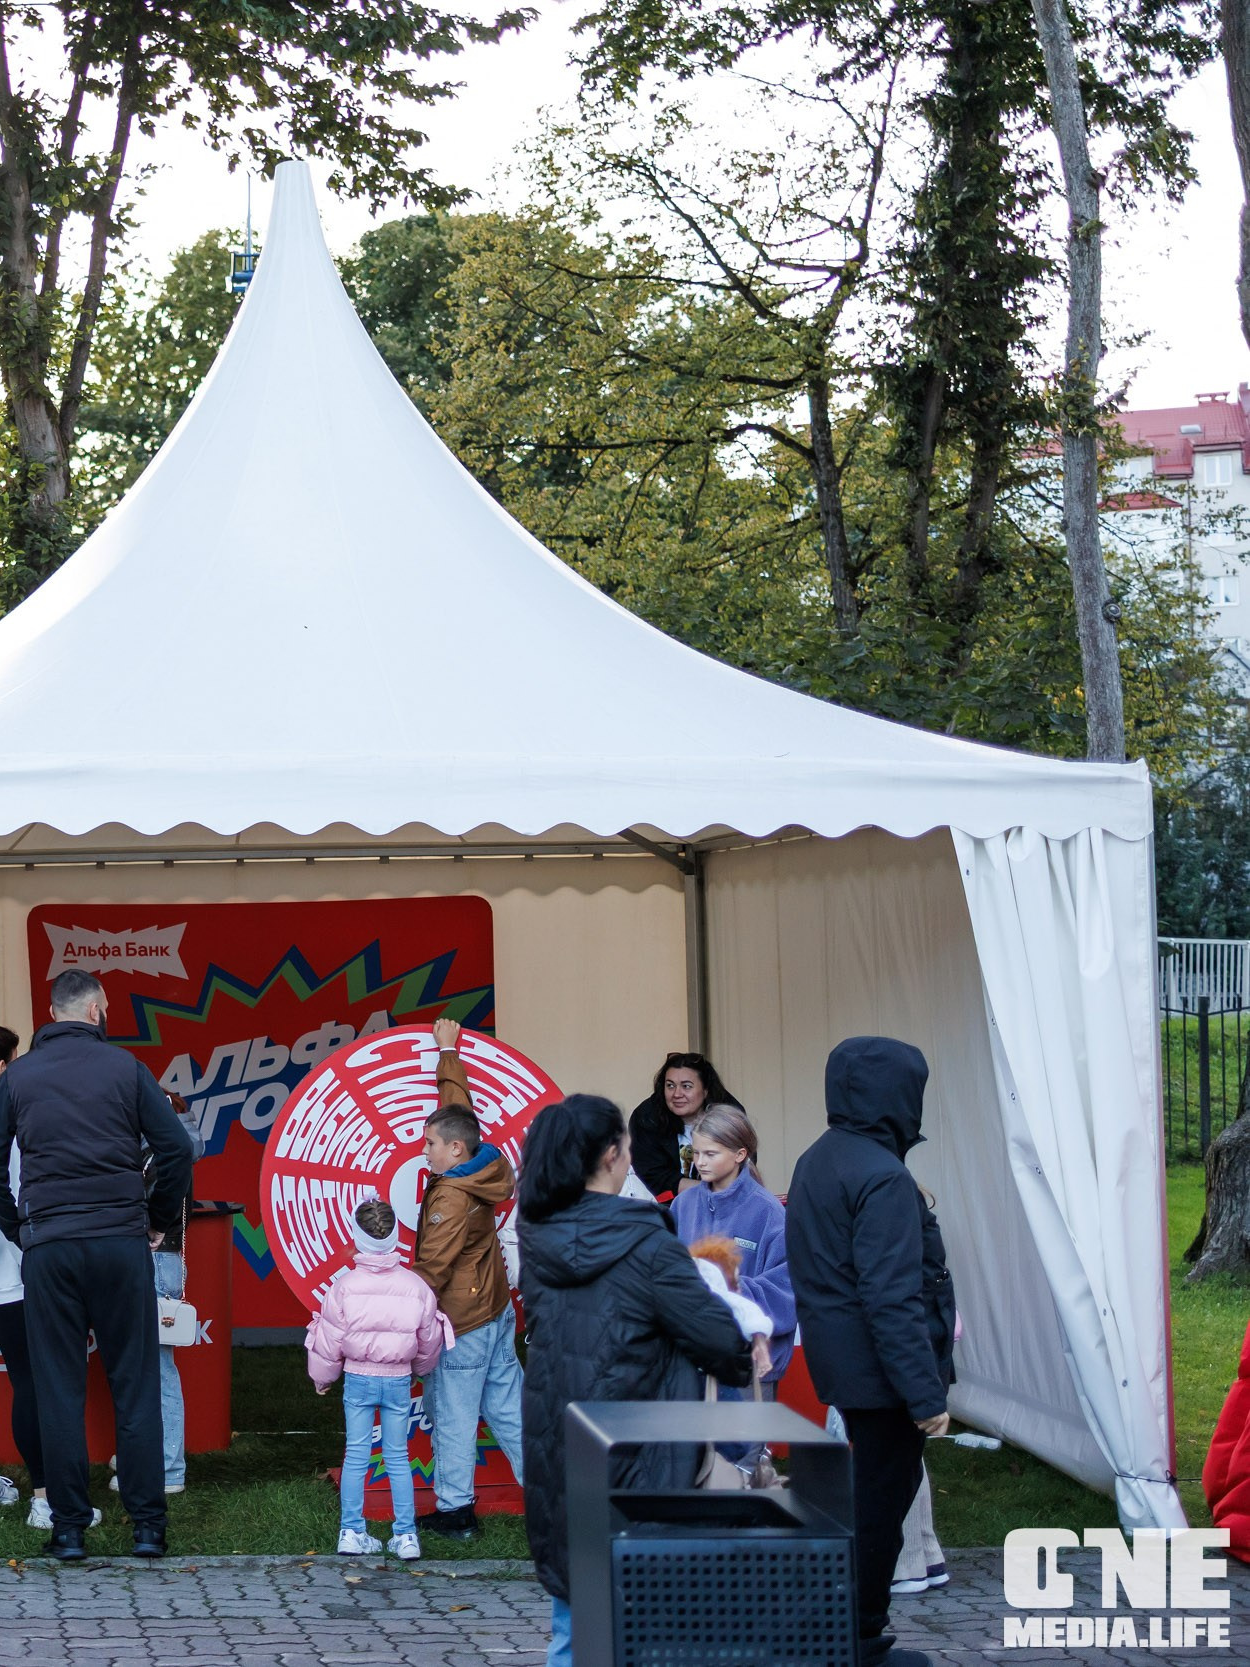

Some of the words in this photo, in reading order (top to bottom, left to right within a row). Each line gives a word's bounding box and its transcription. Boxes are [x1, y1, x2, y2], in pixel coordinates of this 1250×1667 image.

[63, 942, 122, 960] Альфа
[125, 942, 170, 957] Банк
[275, 1067, 397, 1175] ВЫБИРАЙ
[345, 1032, 440, 1144] СТИЛЬ
